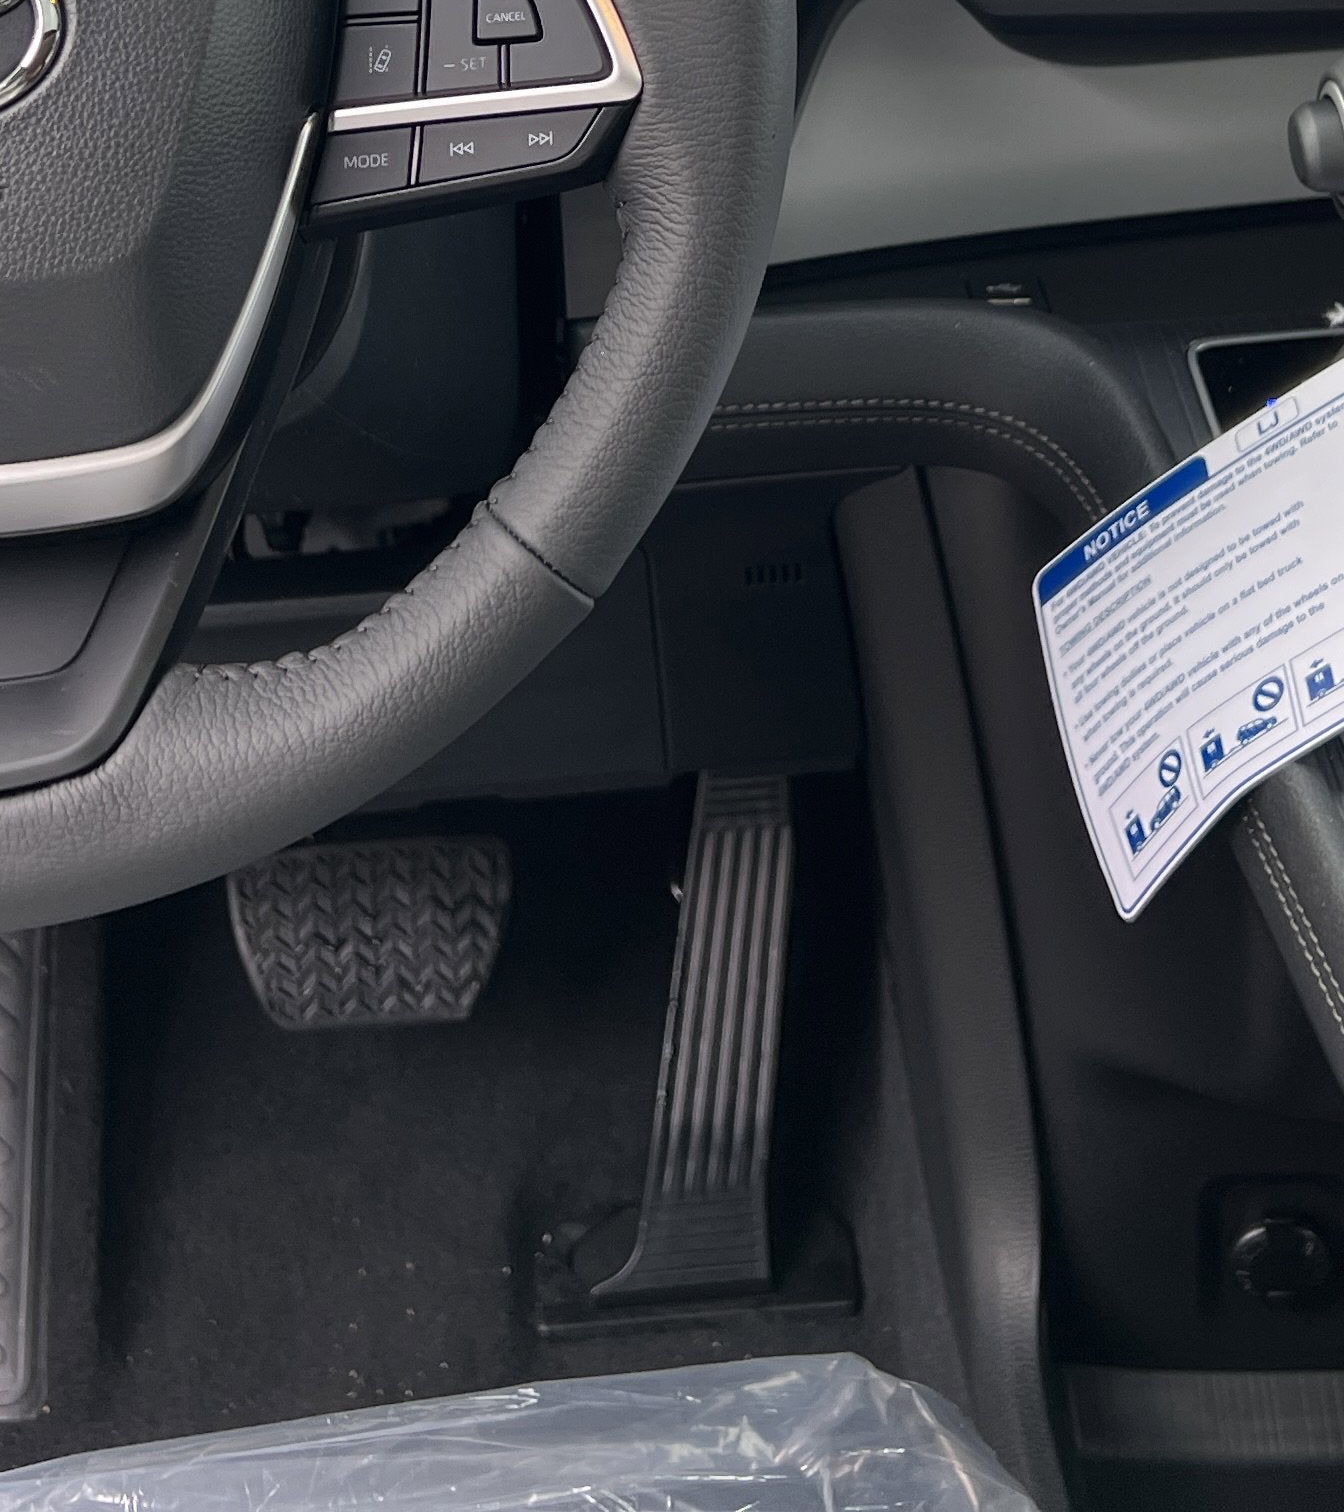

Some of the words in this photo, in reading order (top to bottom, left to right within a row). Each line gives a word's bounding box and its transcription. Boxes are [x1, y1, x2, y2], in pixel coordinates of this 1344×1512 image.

[485, 11, 526, 23] CANCEL
[460, 56, 487, 71] SET
[344, 153, 389, 169] MODE
[1256, 411, 1280, 436] LJ
[1083, 500, 1151, 561] NOTICE
